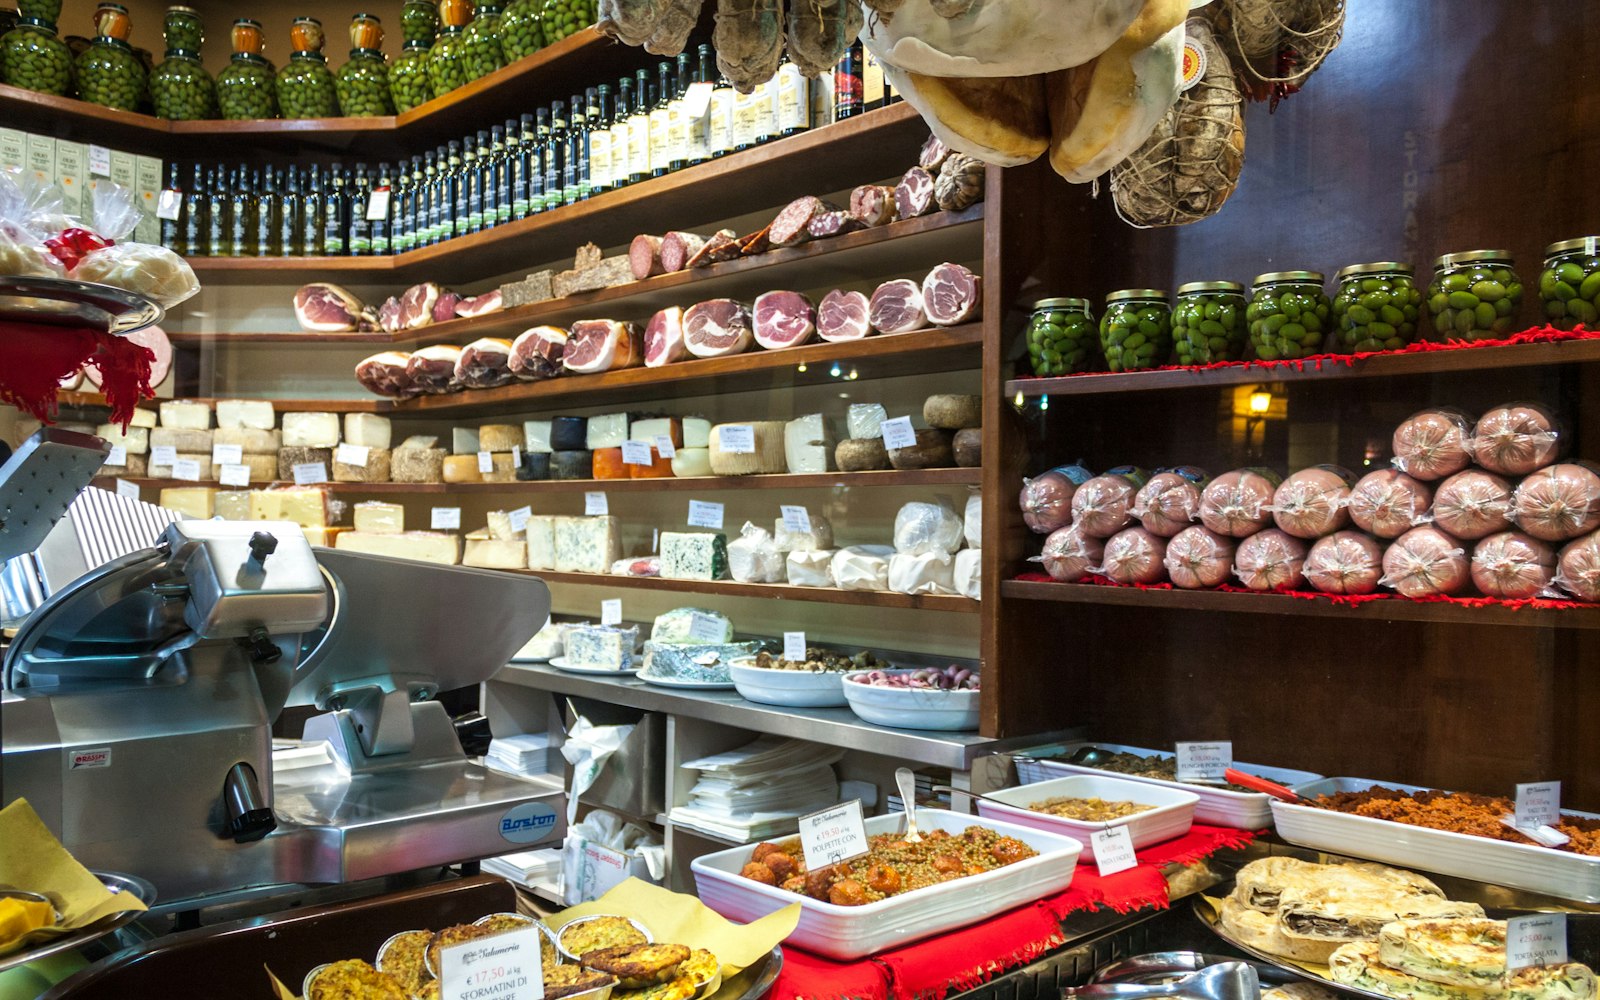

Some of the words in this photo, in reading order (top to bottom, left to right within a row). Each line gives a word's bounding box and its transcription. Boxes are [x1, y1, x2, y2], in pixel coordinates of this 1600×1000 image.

[502, 814, 556, 830] Boston
[812, 839, 841, 853] POLPETTE
[842, 833, 857, 844] CON
[479, 943, 520, 959] Salumeria
[1515, 952, 1533, 960] TORTA
[1534, 949, 1558, 958] SALATA
[466, 976, 472, 985] €
[475, 966, 505, 983] 17,50
[460, 979, 515, 1000] SFORMATINI
[518, 976, 527, 986] DI
